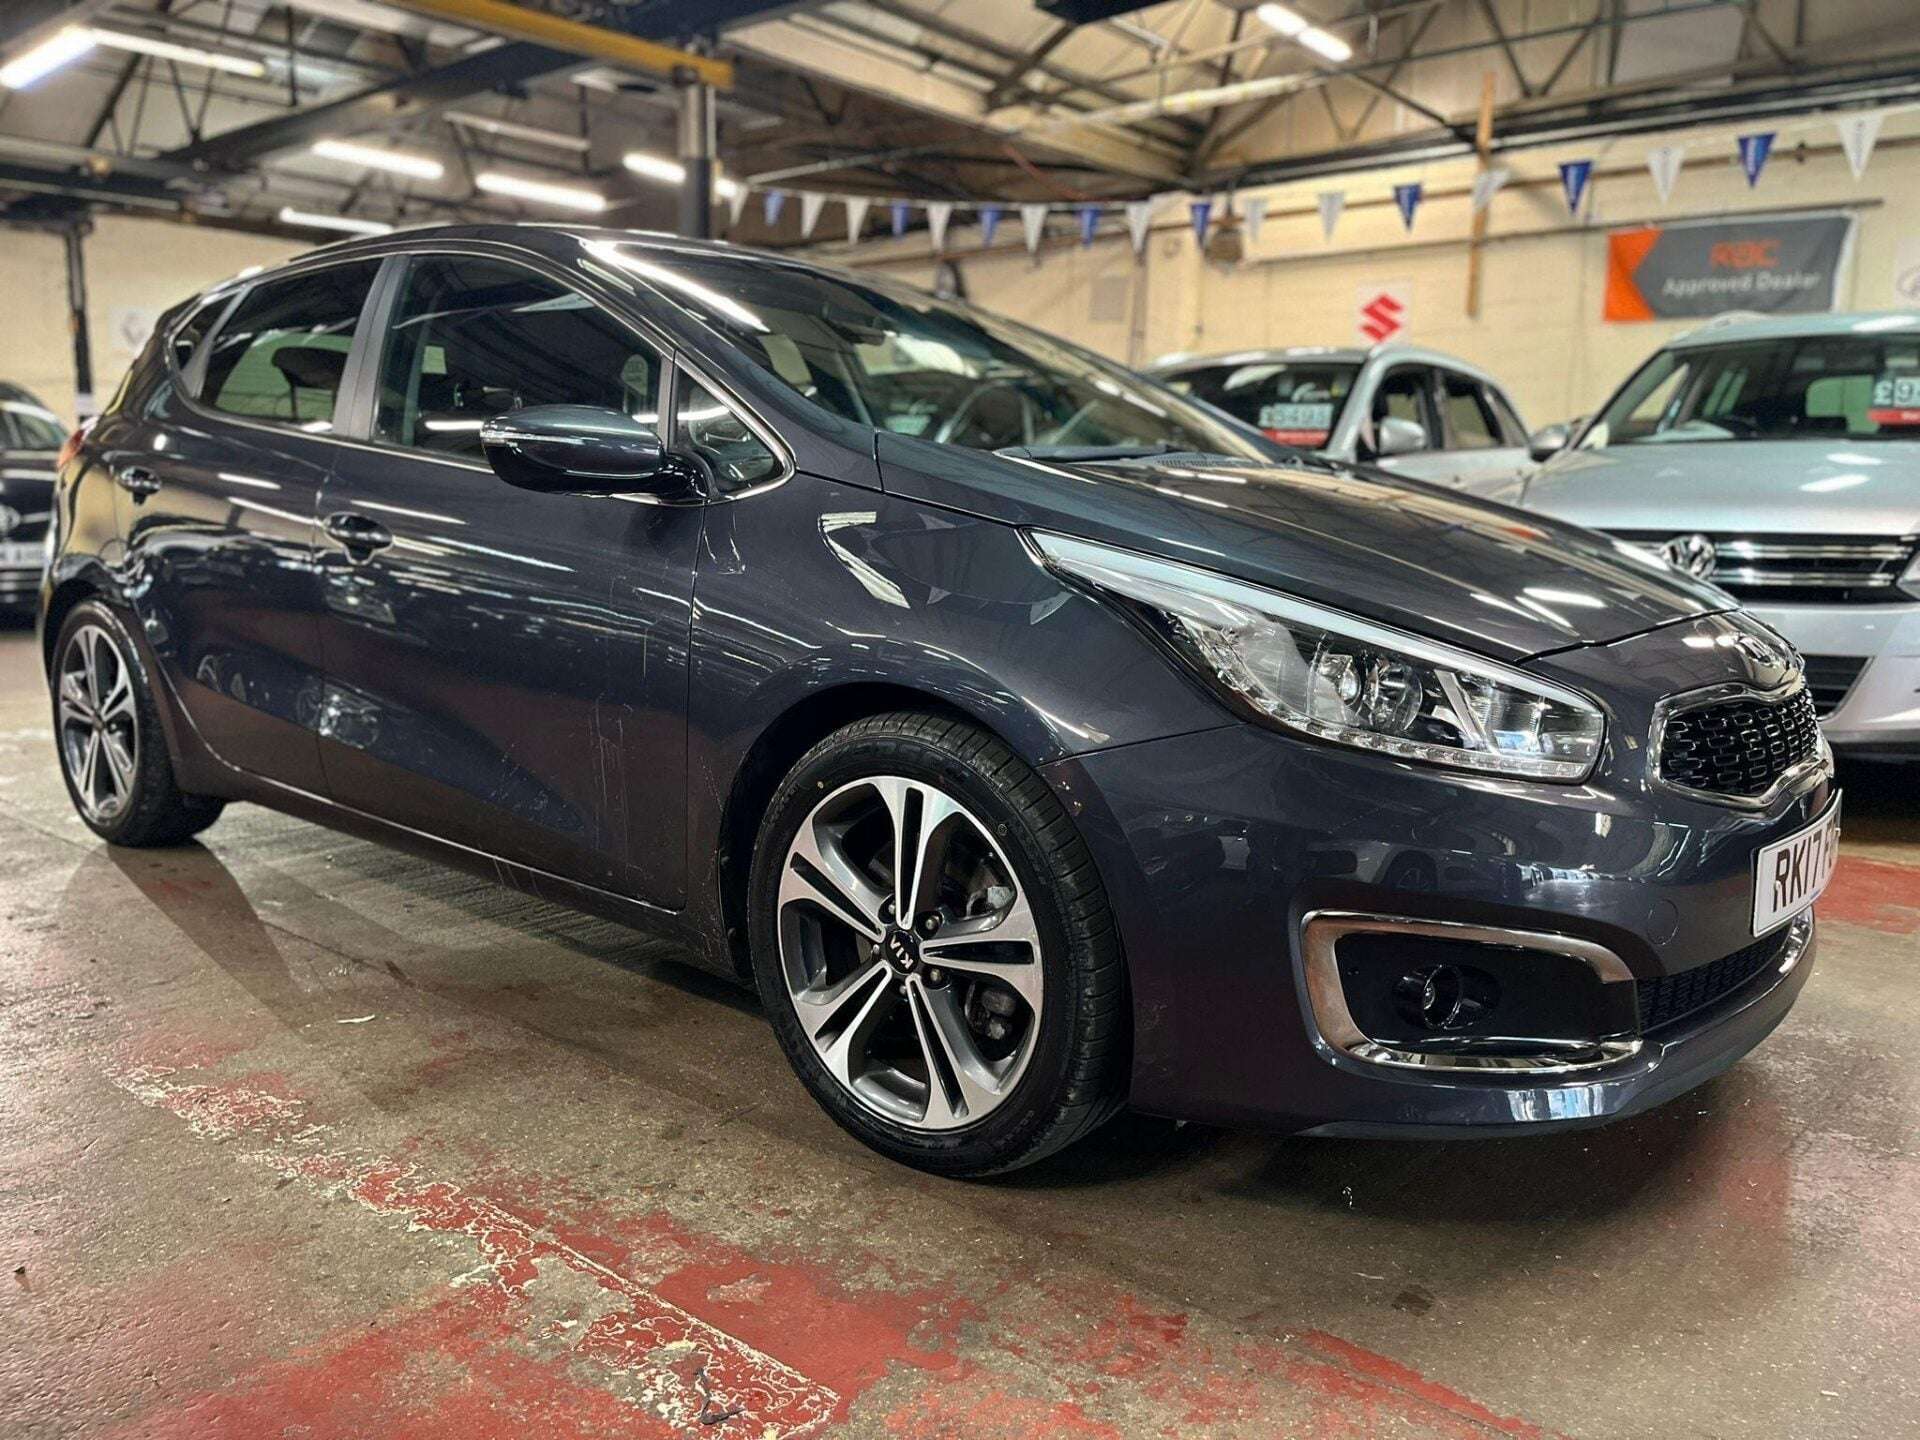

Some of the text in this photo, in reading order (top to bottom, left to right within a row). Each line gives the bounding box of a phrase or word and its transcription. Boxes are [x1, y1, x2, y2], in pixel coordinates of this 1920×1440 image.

[1662, 270, 1820, 298] Approved Dealer
[890, 934, 914, 969] KIA
